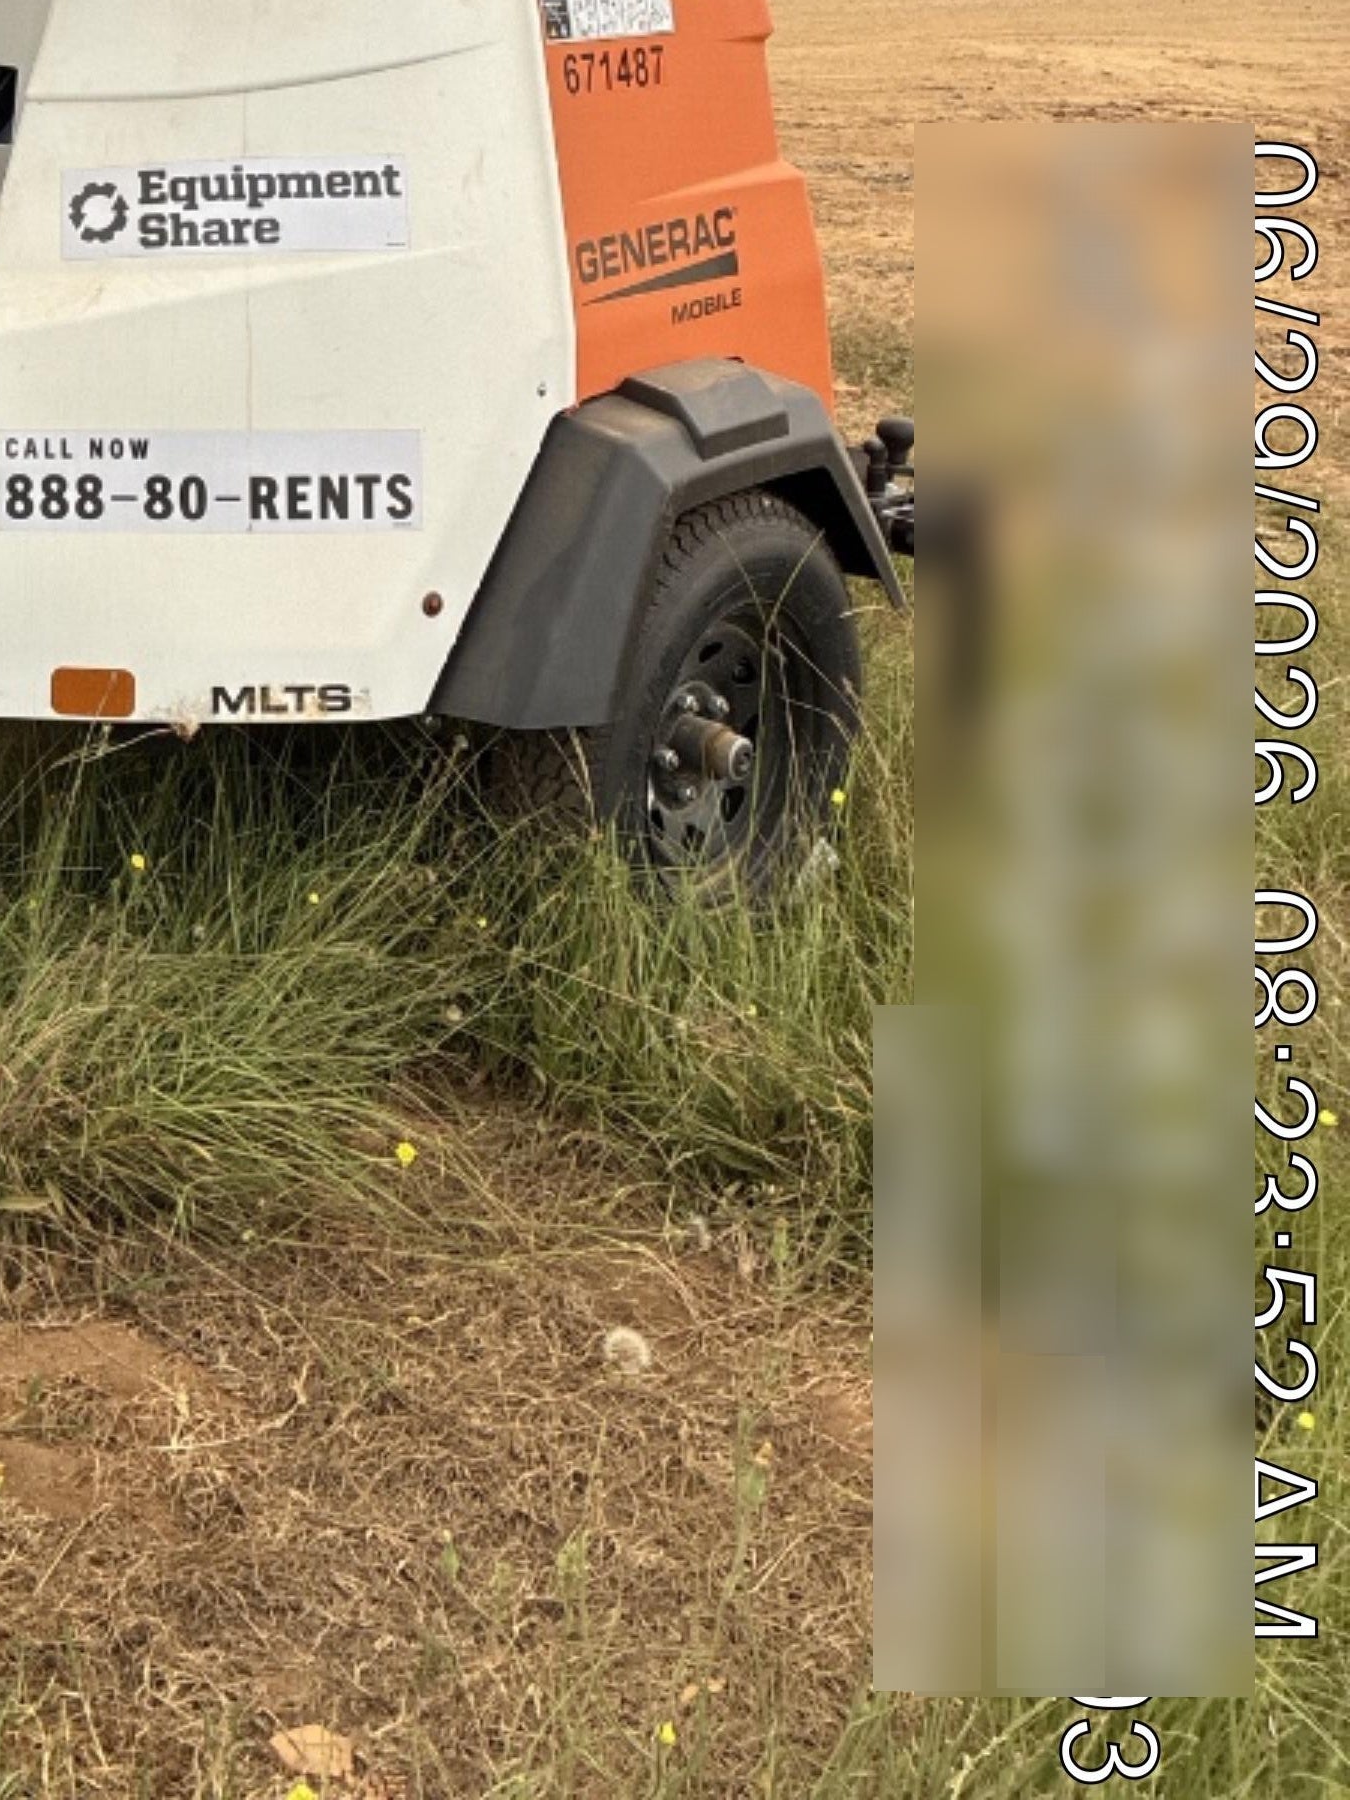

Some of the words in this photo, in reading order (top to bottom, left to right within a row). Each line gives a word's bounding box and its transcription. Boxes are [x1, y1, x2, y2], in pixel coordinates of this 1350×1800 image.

[563, 45, 664, 94] 671487
[138, 165, 401, 210] Equipment
[138, 212, 280, 249] Share
[575, 206, 736, 283] GENERAC
[671, 287, 742, 325] MOBILE
[5, 438, 73, 459] CALL
[89, 438, 149, 459] NOW
[5, 473, 413, 520] 888-80-RENTS
[211, 684, 352, 714] MLTS
